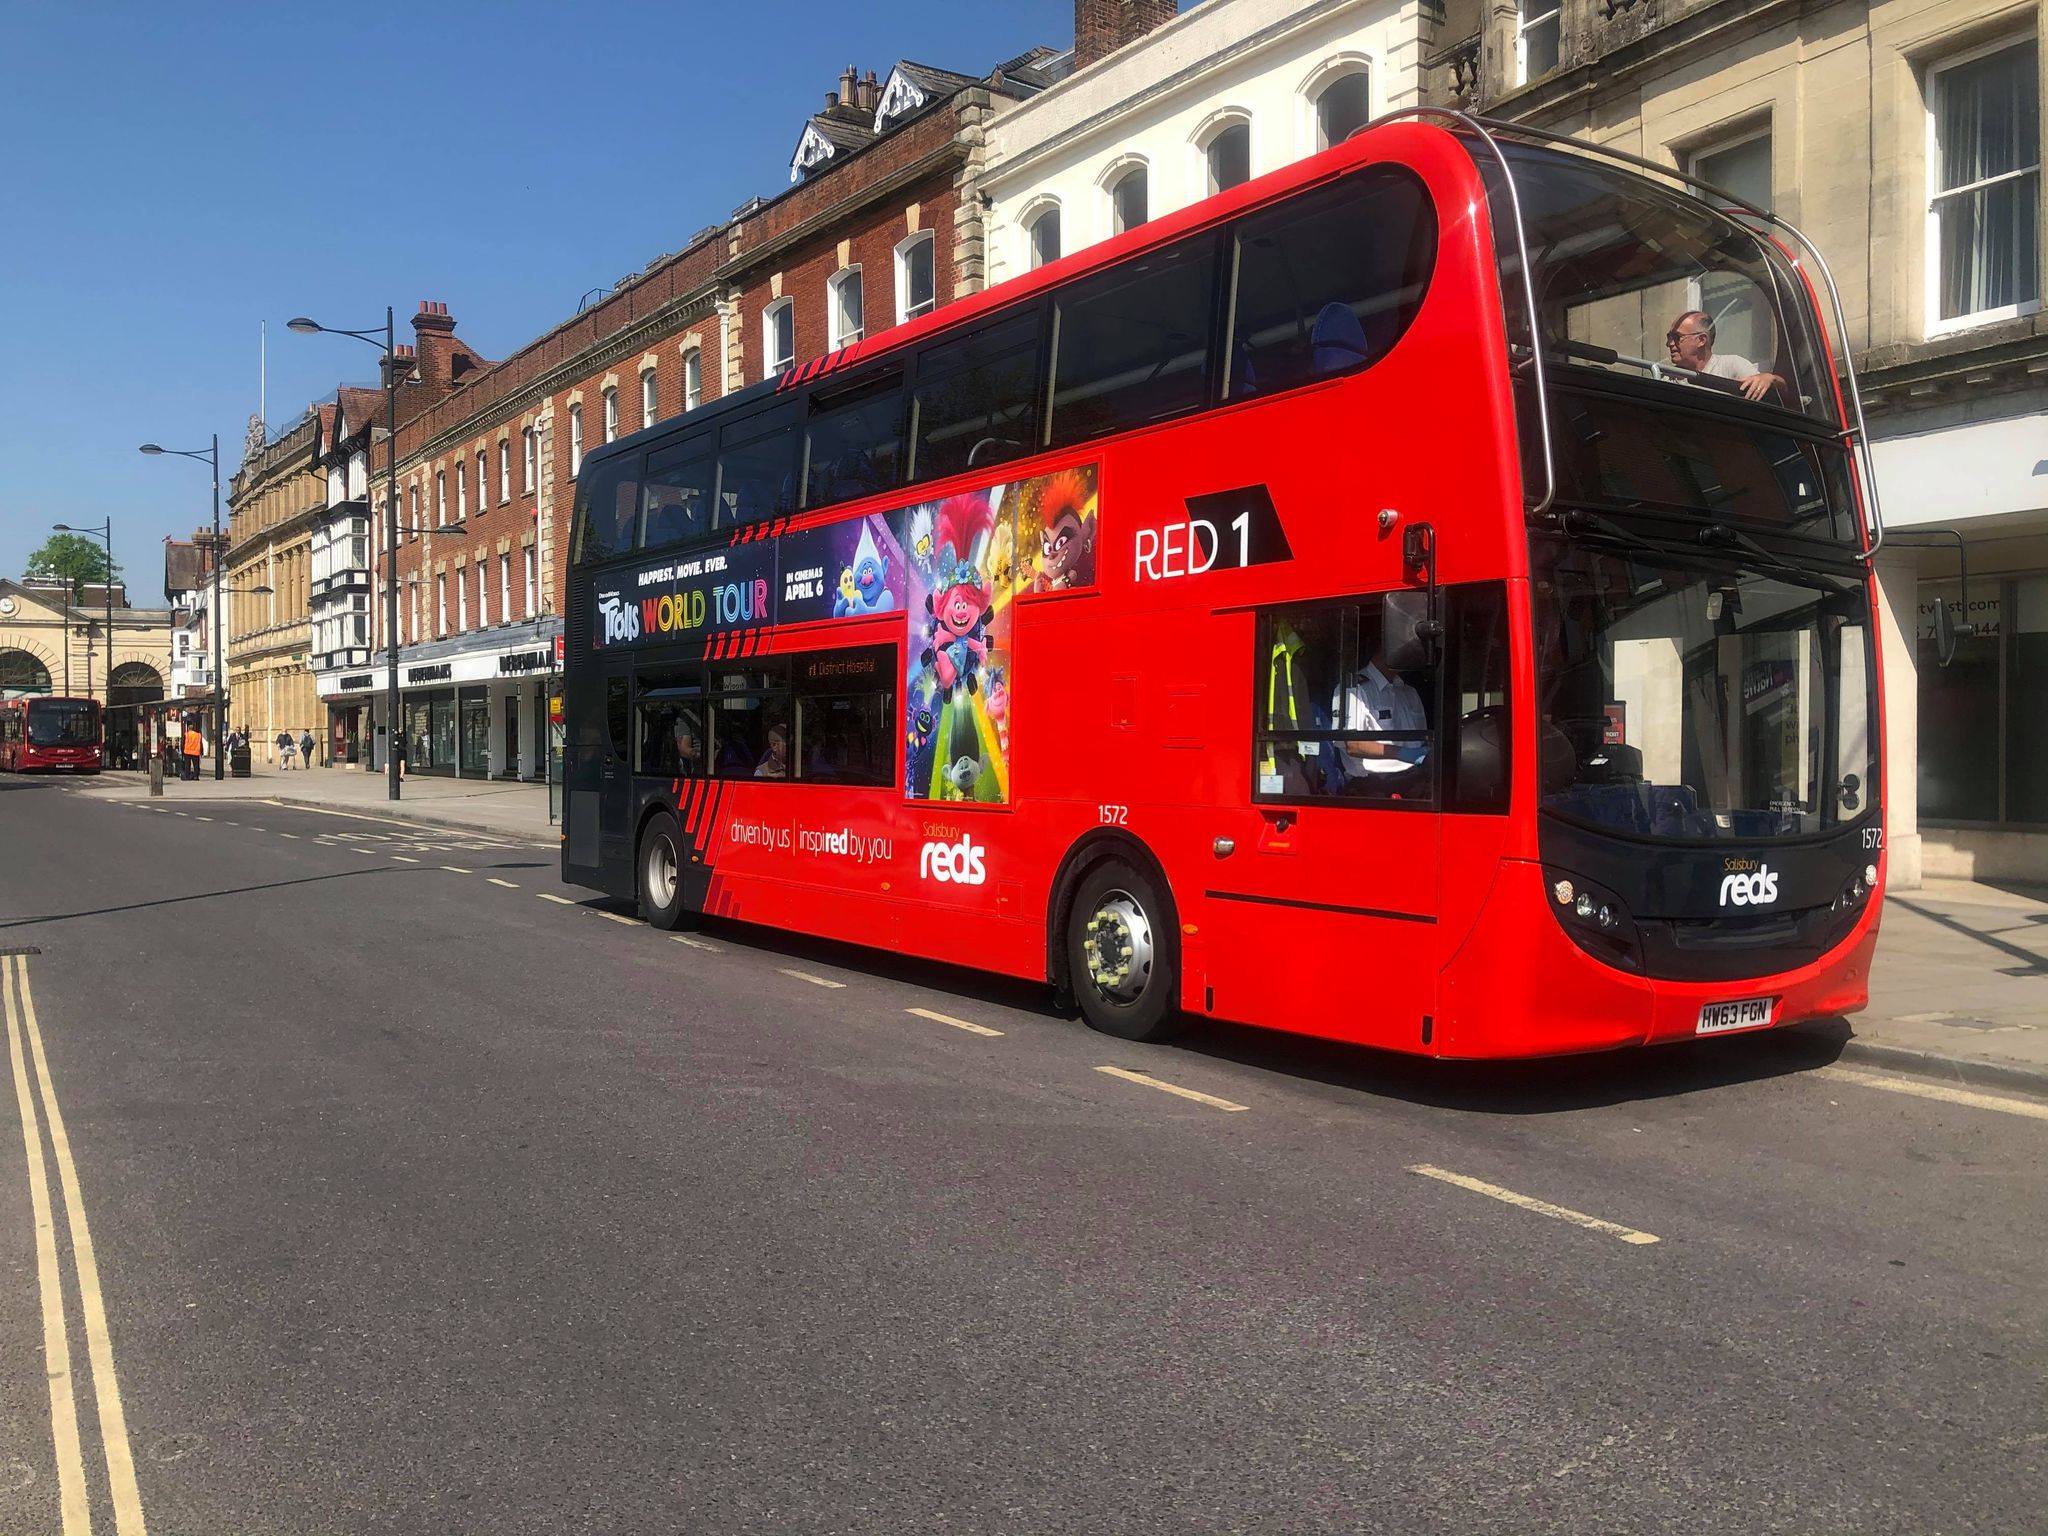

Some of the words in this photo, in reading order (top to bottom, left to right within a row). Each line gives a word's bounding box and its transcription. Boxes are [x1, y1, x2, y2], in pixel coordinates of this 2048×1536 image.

[1135, 519, 1218, 582] RED
[1231, 511, 1249, 567] 1
[638, 567, 674, 586] HAPPIEST.
[676, 561, 703, 579] MOVIE.
[705, 556, 728, 571] EVER.
[786, 572, 794, 583] IN
[794, 567, 823, 581] CINEMAS
[785, 582, 814, 601] APRIL
[816, 580, 824, 596] 6
[642, 590, 706, 634] WORLD
[713, 579, 768, 625] TOUR
[1098, 804, 1128, 825] 1572
[731, 819, 760, 844] driven
[762, 822, 774, 852] by
[777, 828, 790, 848] us
[800, 825, 848, 857] inspired
[850, 829, 864, 862] by
[868, 836, 892, 864] you
[923, 821, 960, 841] Salisbury
[1861, 828, 1883, 849] 1572
[920, 833, 986, 885] reds
[1724, 857, 1758, 871] Salisbury
[1719, 864, 1779, 906] reds
[1702, 1005, 1739, 1028] HW63
[1741, 1001, 1767, 1023] FGN
